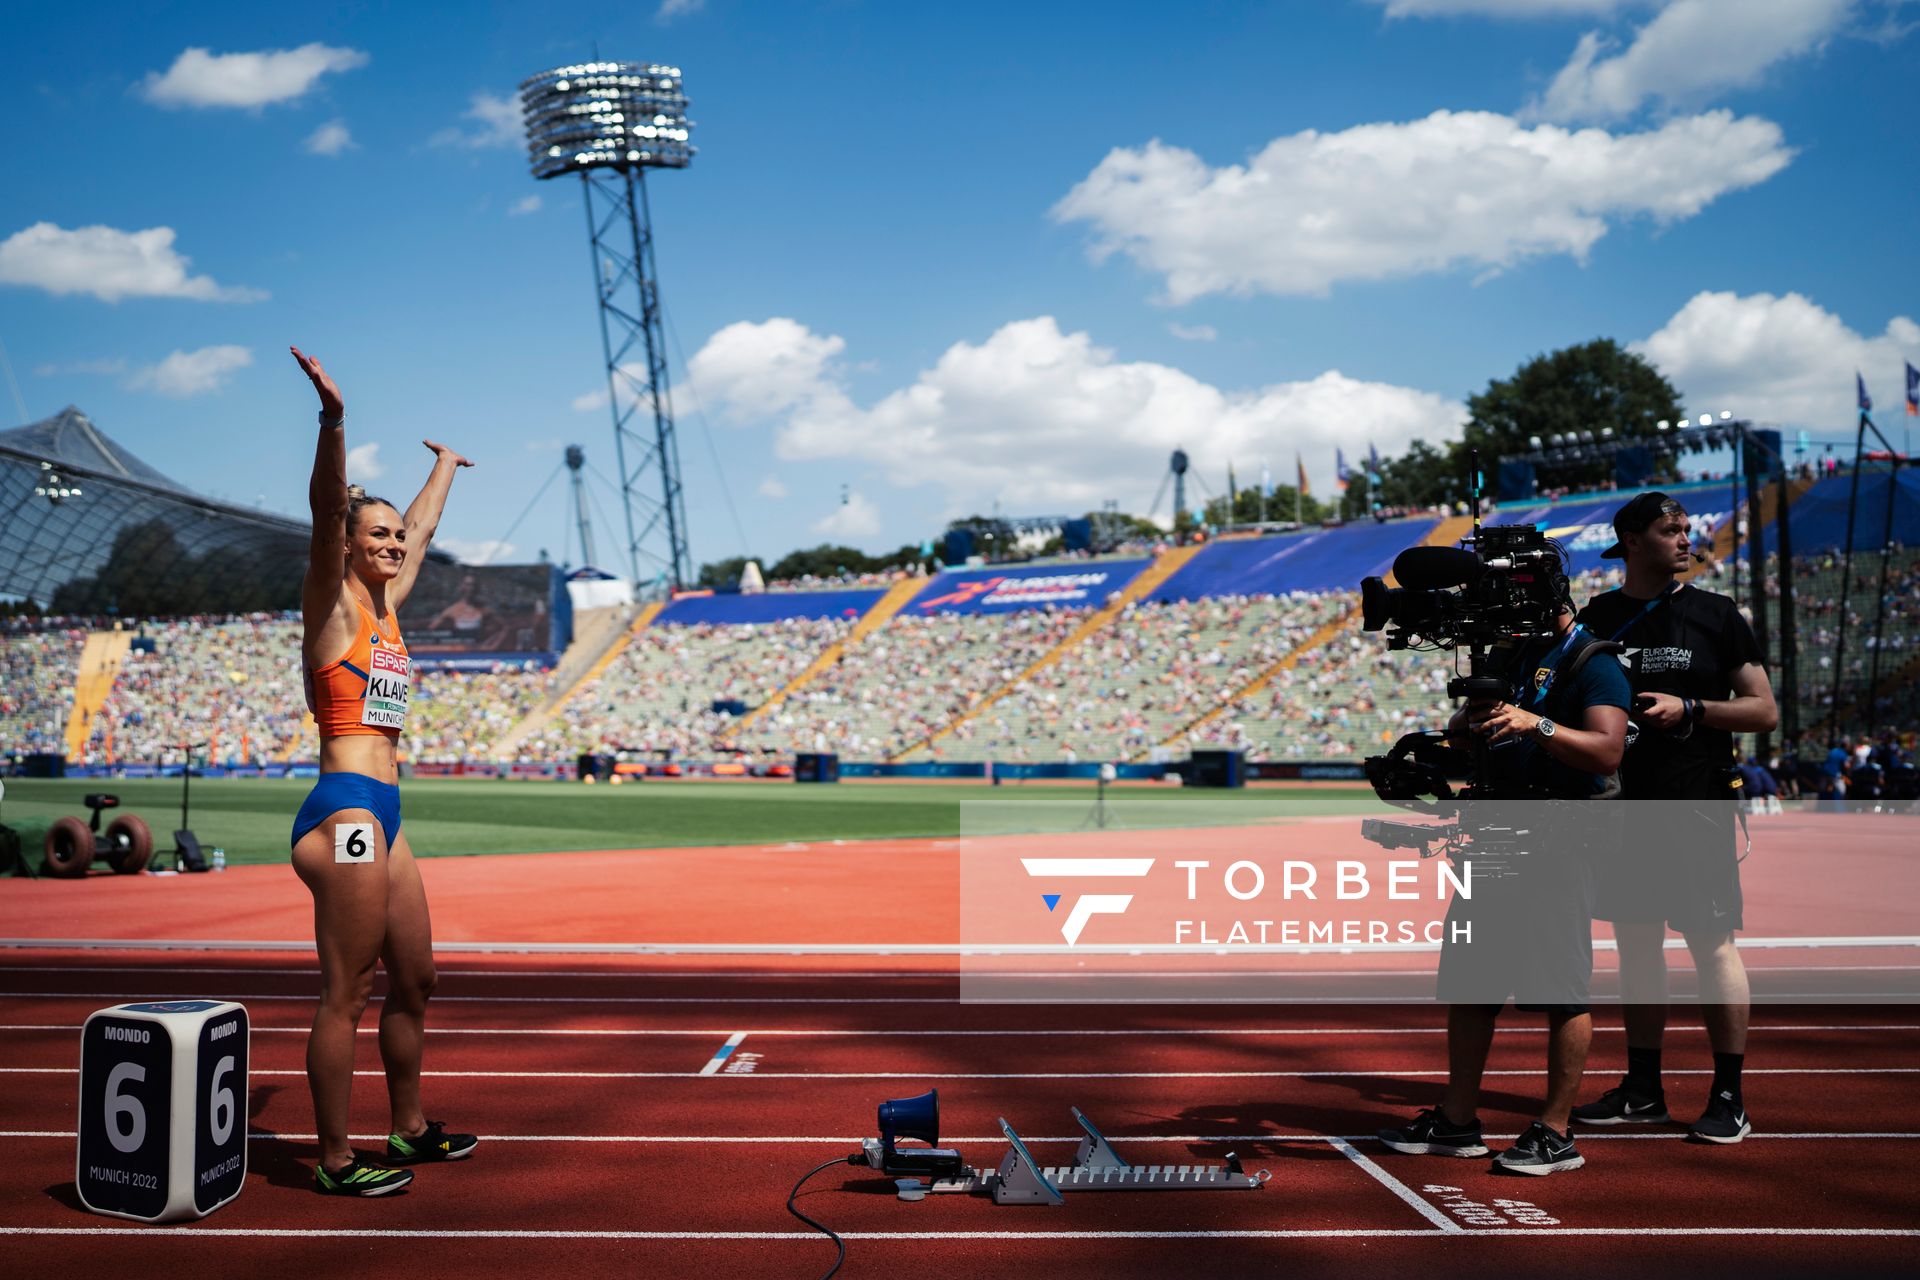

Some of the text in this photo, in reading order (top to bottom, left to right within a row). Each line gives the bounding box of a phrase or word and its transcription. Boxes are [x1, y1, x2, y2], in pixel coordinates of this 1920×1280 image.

[374, 652, 408, 673] SPAR
[1642, 647, 1693, 658] EUROPEAN
[1641, 662, 1691, 671] MUNICH 2022
[346, 828, 367, 858] 6
[104, 1026, 151, 1044] MONDO
[210, 1020, 238, 1042] MONDO
[103, 1061, 147, 1154] 6
[209, 1055, 236, 1147] 6
[89, 1165, 158, 1190] MUNICH 2022
[200, 1154, 241, 1187] MUNICH 2022
